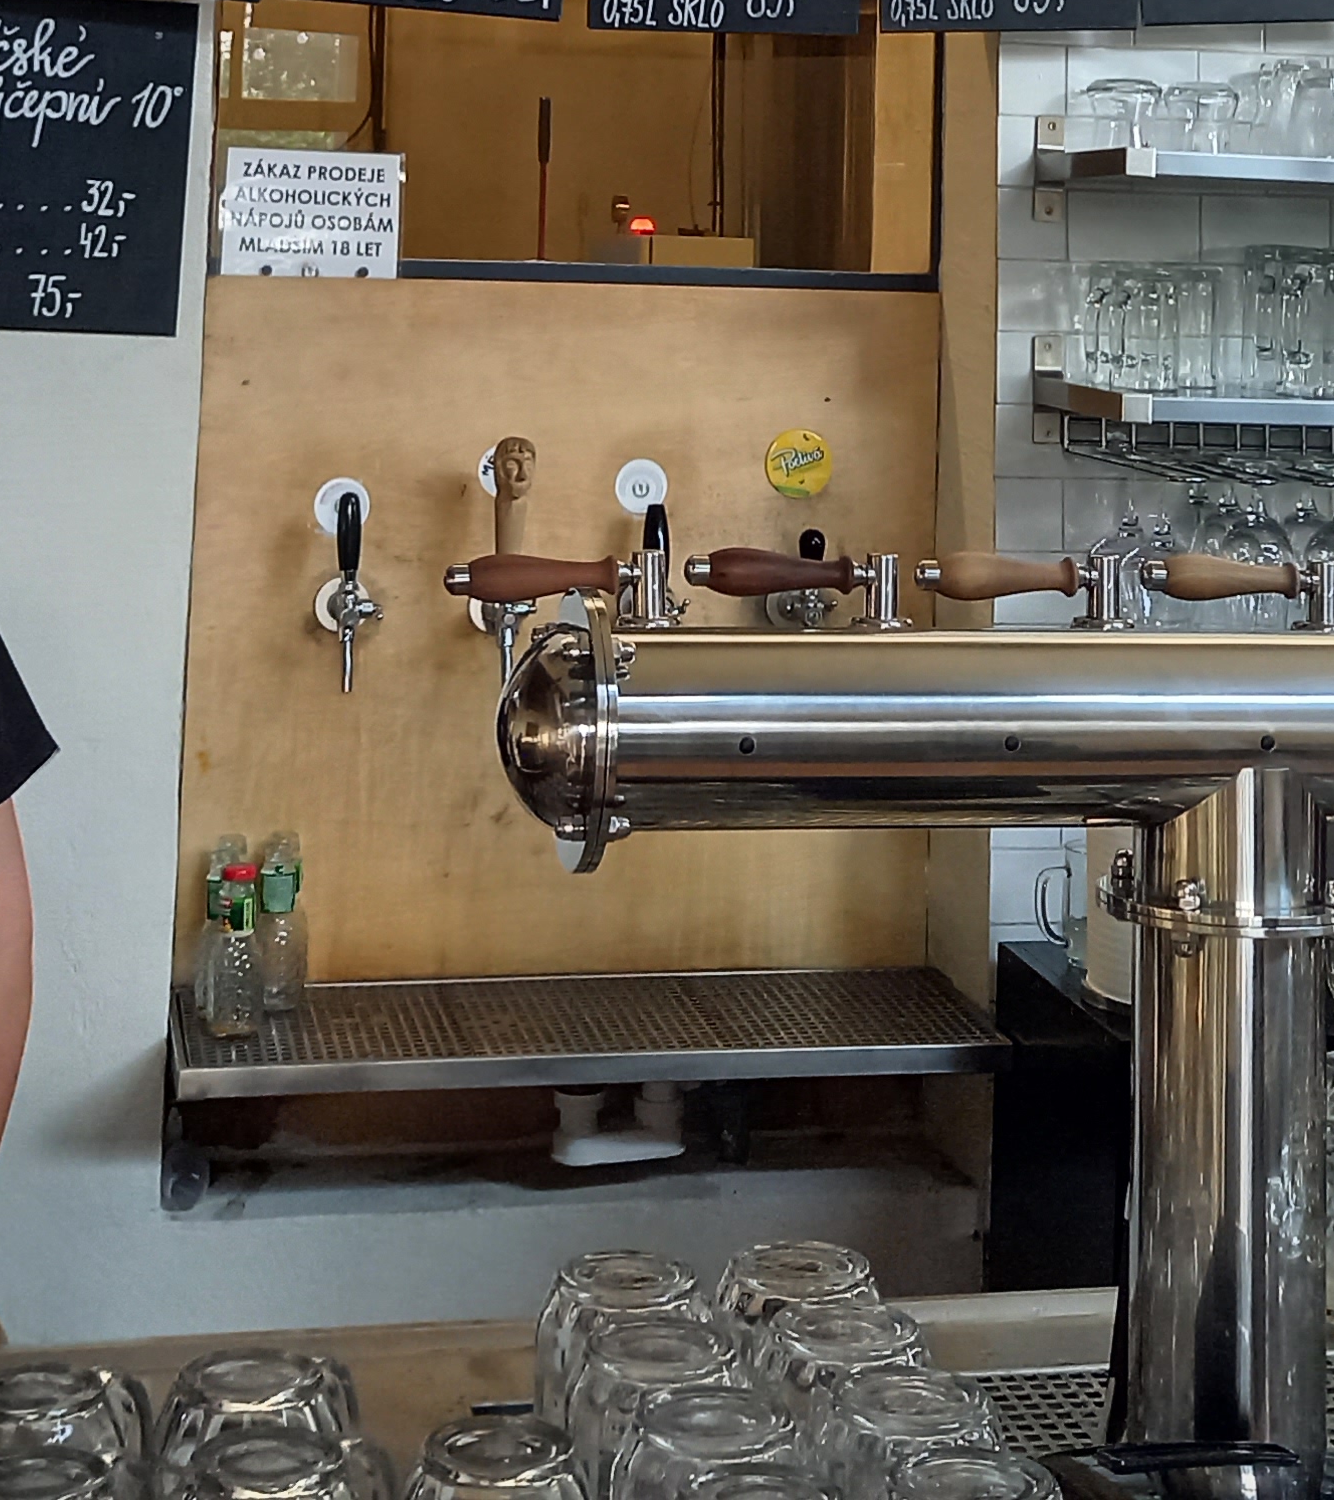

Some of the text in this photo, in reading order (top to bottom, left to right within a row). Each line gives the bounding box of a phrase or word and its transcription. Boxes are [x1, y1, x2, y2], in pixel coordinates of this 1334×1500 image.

[132, 83, 183, 128] 10°
[243, 158, 385, 183] ZÁKAZ PRODEJE
[235, 187, 391, 207] ALKOHOLICKÝCH
[232, 208, 393, 233] NÁPOJŮ OSOBÁM
[332, 241, 350, 255] 18
[357, 243, 382, 257] LET
